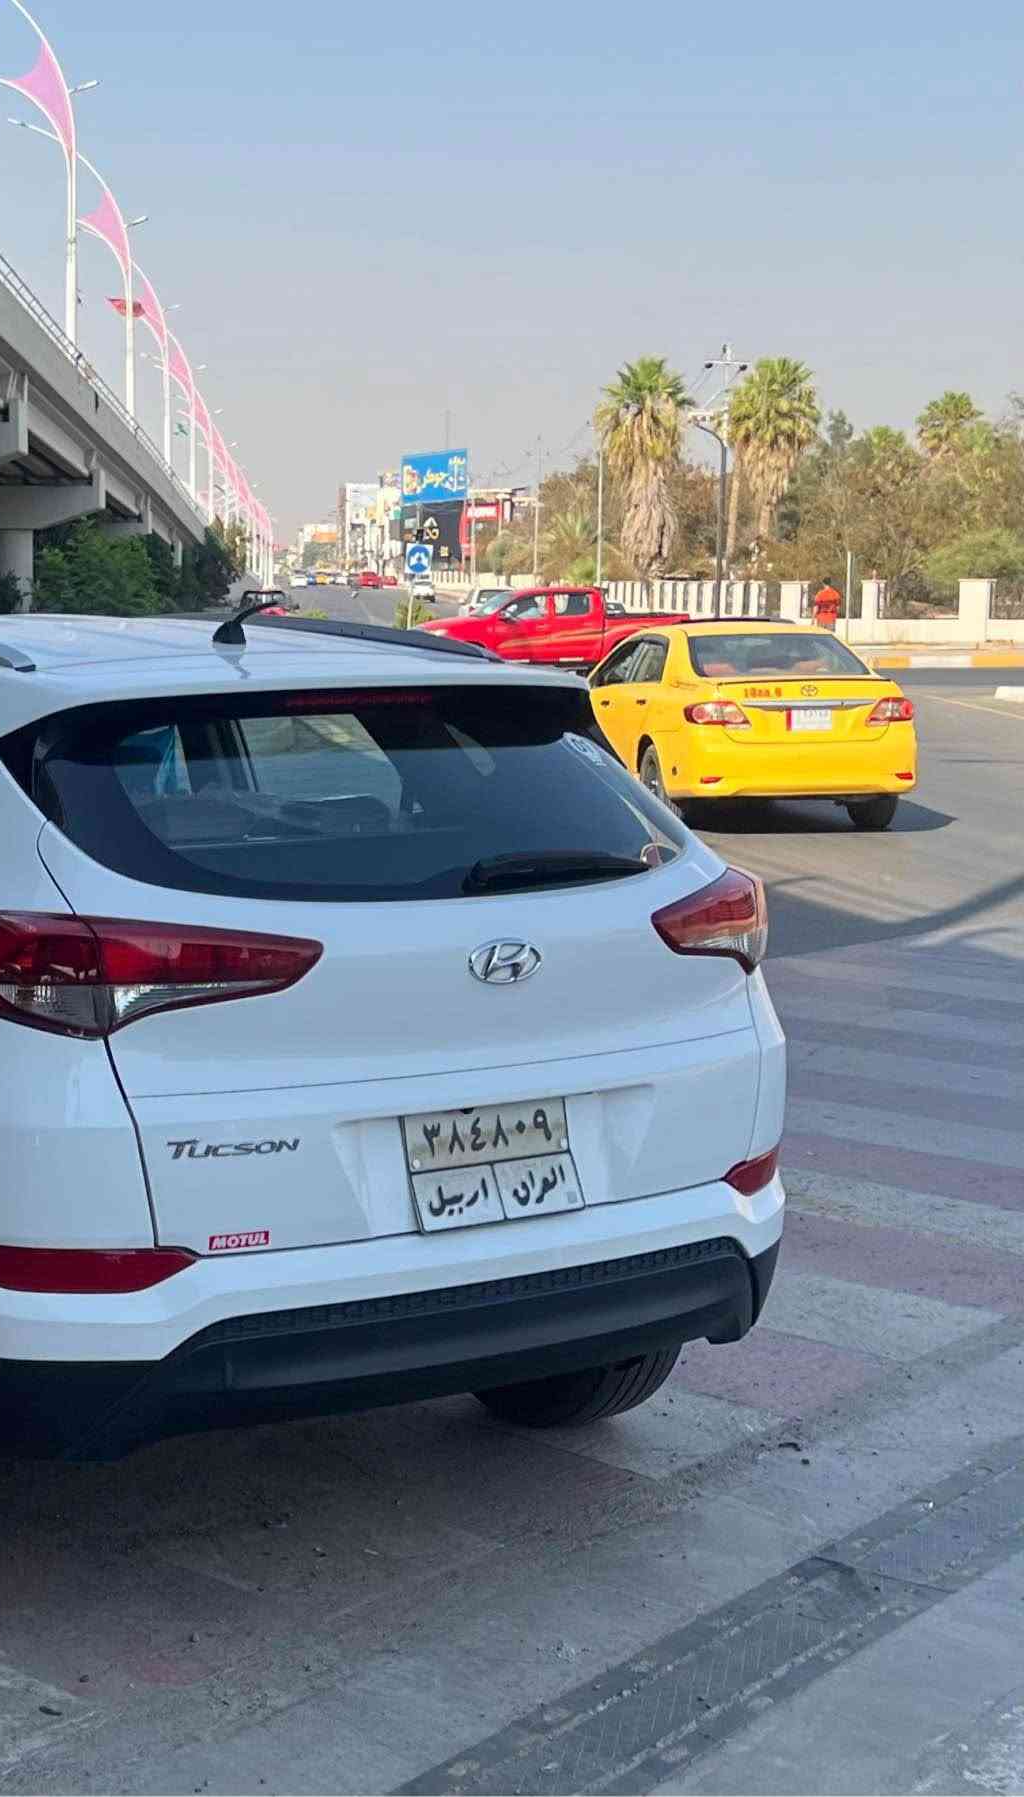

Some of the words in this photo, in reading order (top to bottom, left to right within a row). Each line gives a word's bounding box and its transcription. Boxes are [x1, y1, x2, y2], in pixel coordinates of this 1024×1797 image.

[422, 1108, 553, 1158] ٣٨٤٨٠٩
[167, 1138, 301, 1160] TUCSON
[429, 1177, 489, 1217] اربيل
[210, 1232, 268, 1250] MOTUL
